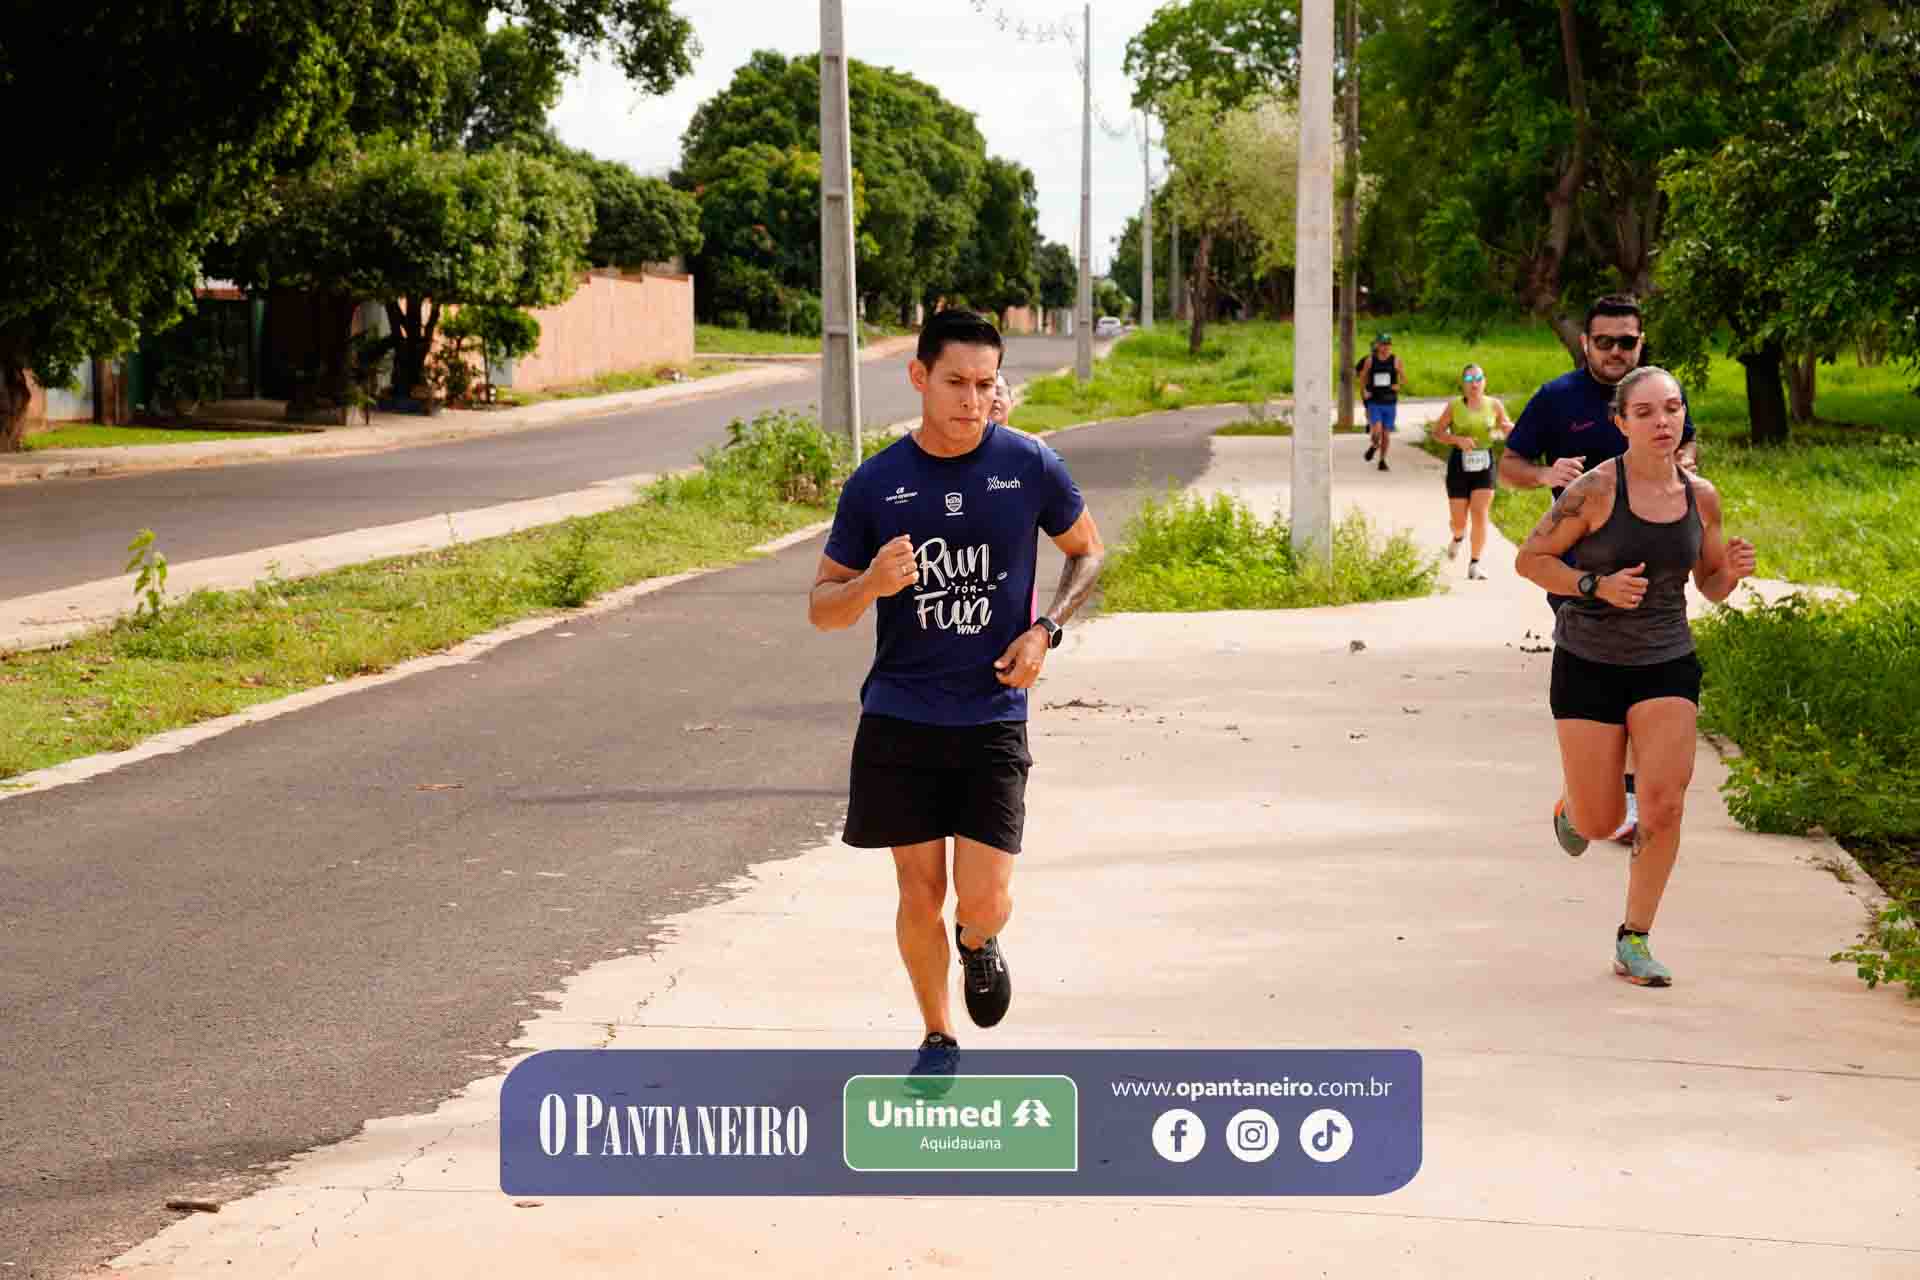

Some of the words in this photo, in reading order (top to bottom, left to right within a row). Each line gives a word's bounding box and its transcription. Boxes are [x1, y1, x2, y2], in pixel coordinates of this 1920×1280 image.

[987, 476, 1021, 491] Xtouch
[913, 537, 990, 588] Run
[954, 584, 977, 594] FOR
[914, 590, 992, 630] Fun
